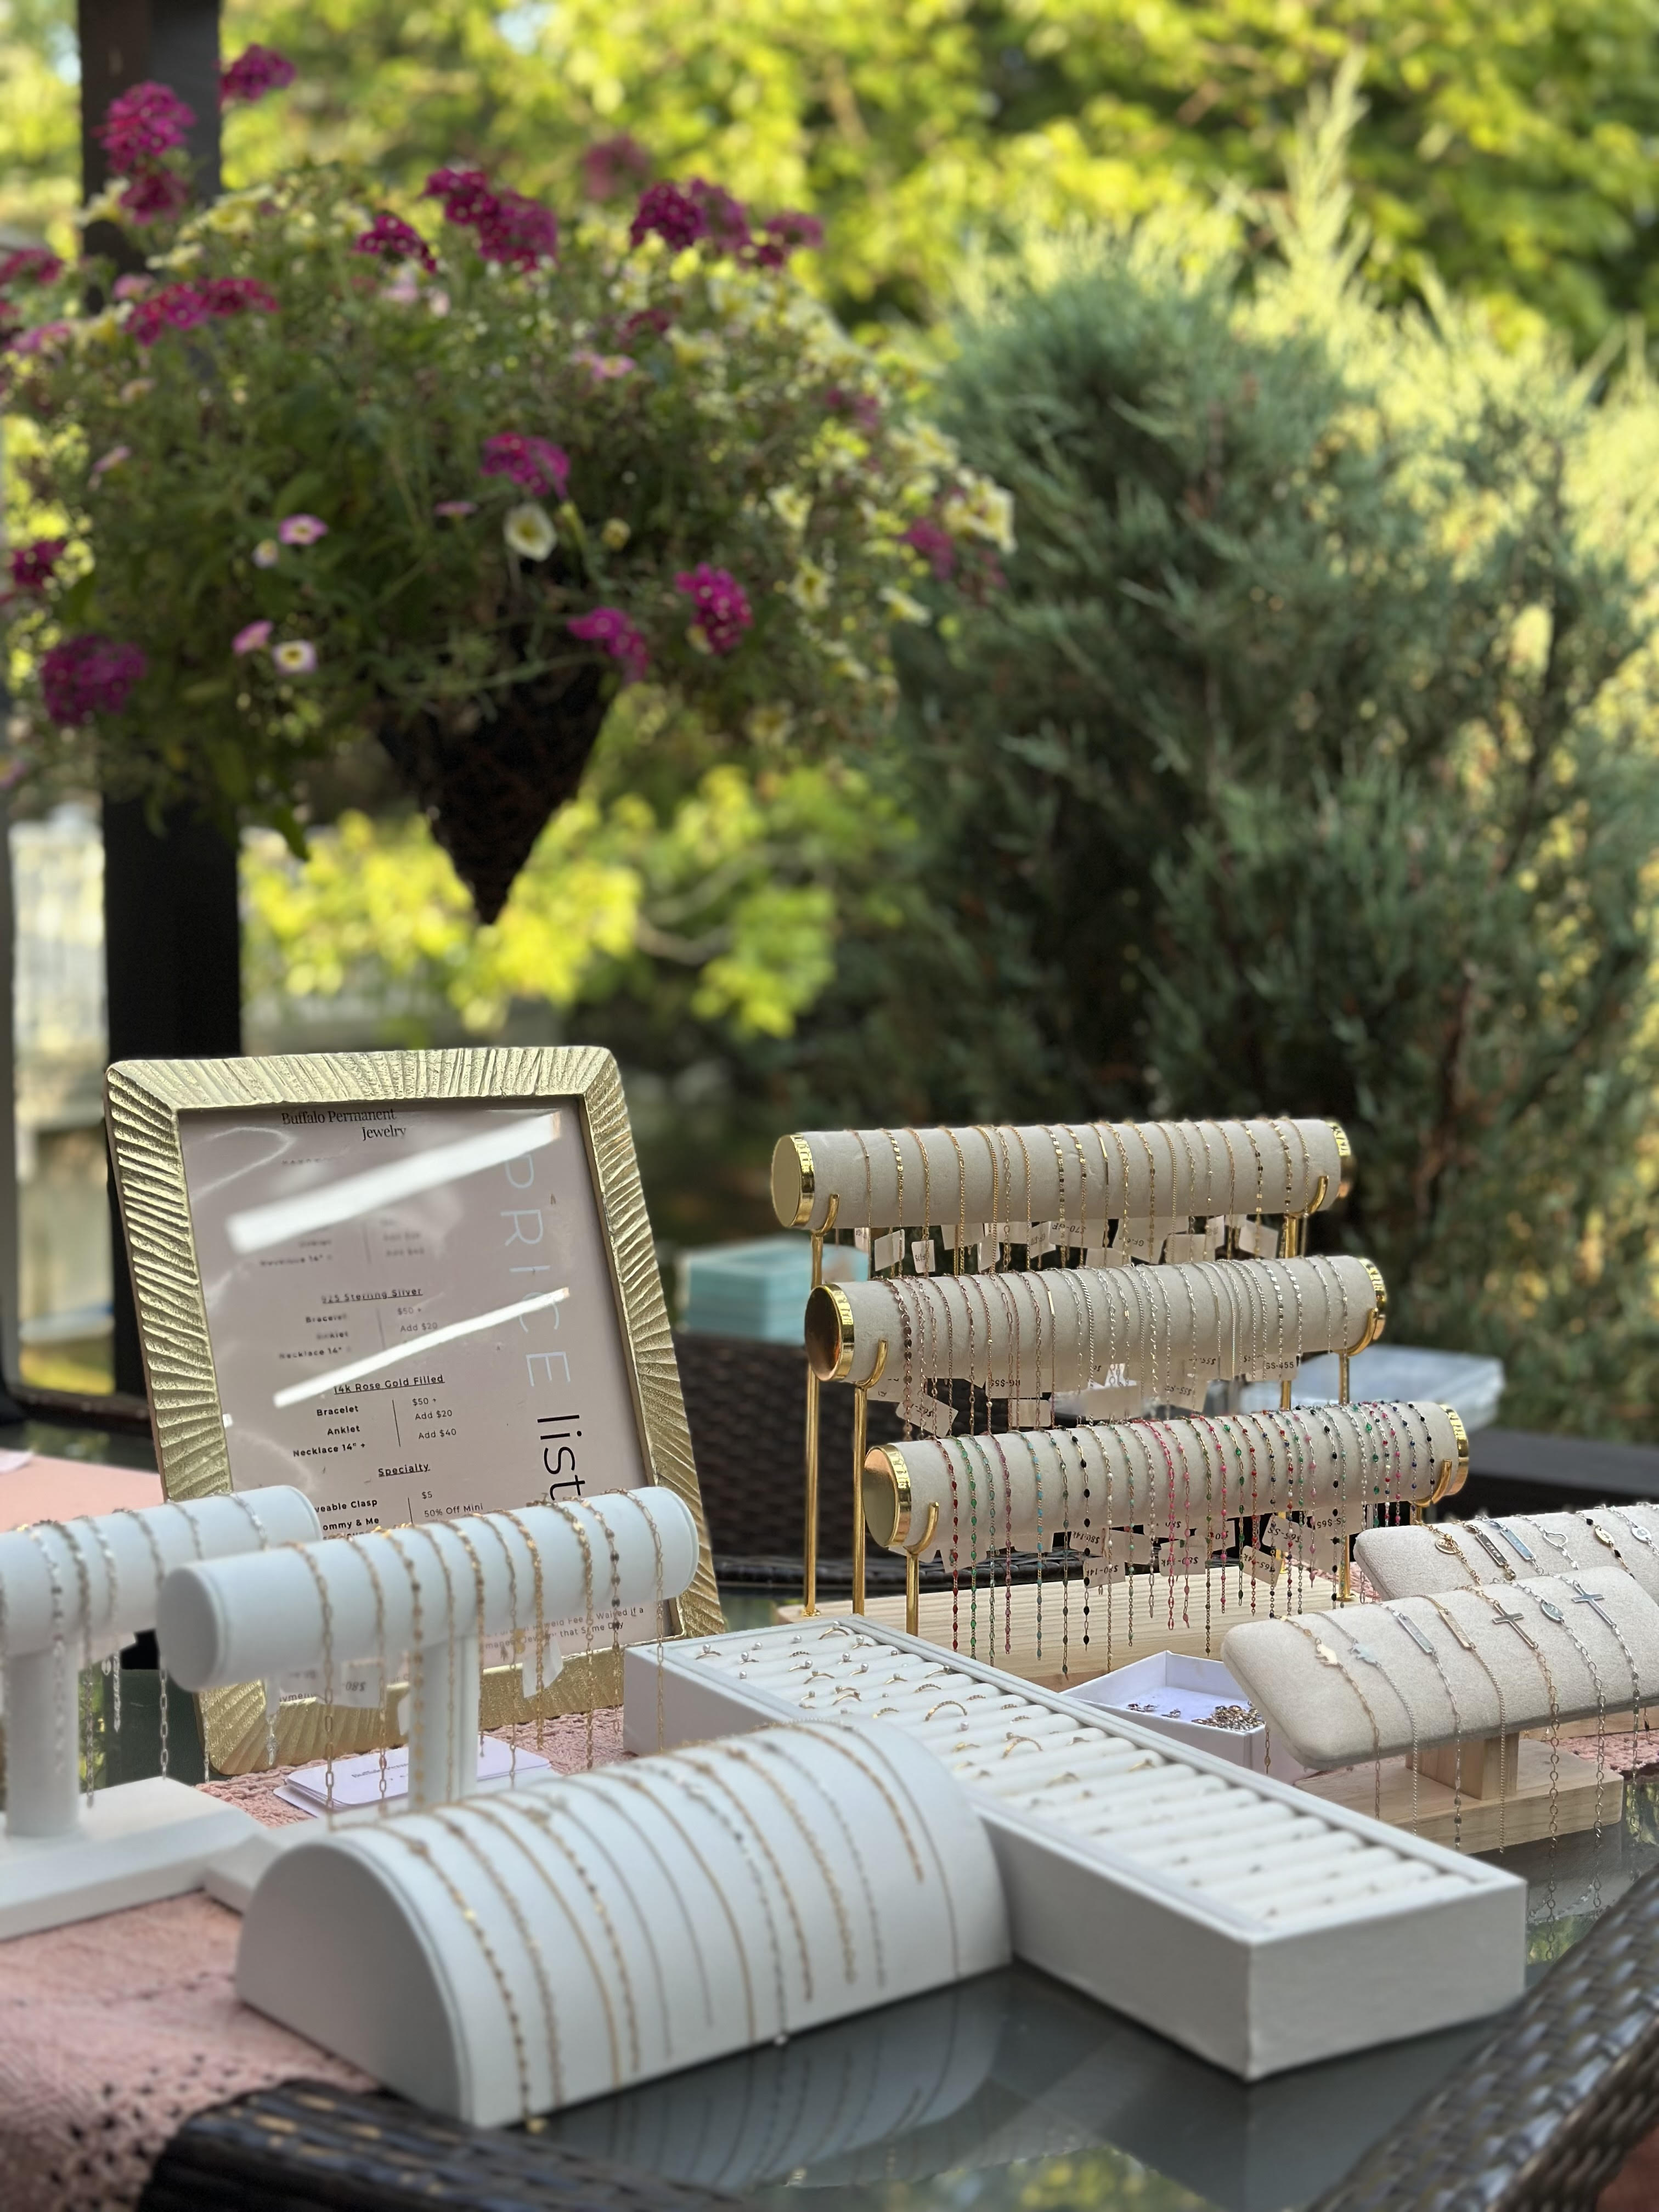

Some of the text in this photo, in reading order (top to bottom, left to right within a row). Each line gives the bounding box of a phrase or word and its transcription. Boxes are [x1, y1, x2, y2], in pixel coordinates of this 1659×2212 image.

[281, 1109, 397, 1125] Buffalo Permanent
[362, 1125, 407, 1141] Jewelry
[392, 1289, 422, 1297] Silver
[398, 1307, 414, 1315] $50
[400, 1324, 418, 1333] Add
[421, 1322, 438, 1331] $20
[500, 1152, 585, 1500] PRICE list
[334, 1374, 444, 1394] 14k Rose Gold Filled
[317, 1406, 359, 1417] Bracelet
[413, 1397, 429, 1406] $50
[327, 1409, 453, 1436] Anklet Add $20
[293, 1446, 338, 1457] Necklace
[419, 1431, 436, 1440] Add
[439, 1428, 456, 1437] $40
[378, 1463, 429, 1477] Specialty
[315, 1491, 433, 1513] veable Clasp $5
[323, 1521, 352, 1531] ommy
[365, 1517, 380, 1525] Me
[425, 1508, 443, 1517] 50%
[446, 1505, 460, 1515] Off
[464, 1503, 483, 1512] Mini
[1161, 1557, 1199, 1567] $80-4k
[1243, 1553, 1276, 1572] $65-4k
[560, 1628, 578, 1638] that
[581, 1624, 605, 1634] Sme
[608, 1622, 623, 1630] Dy
